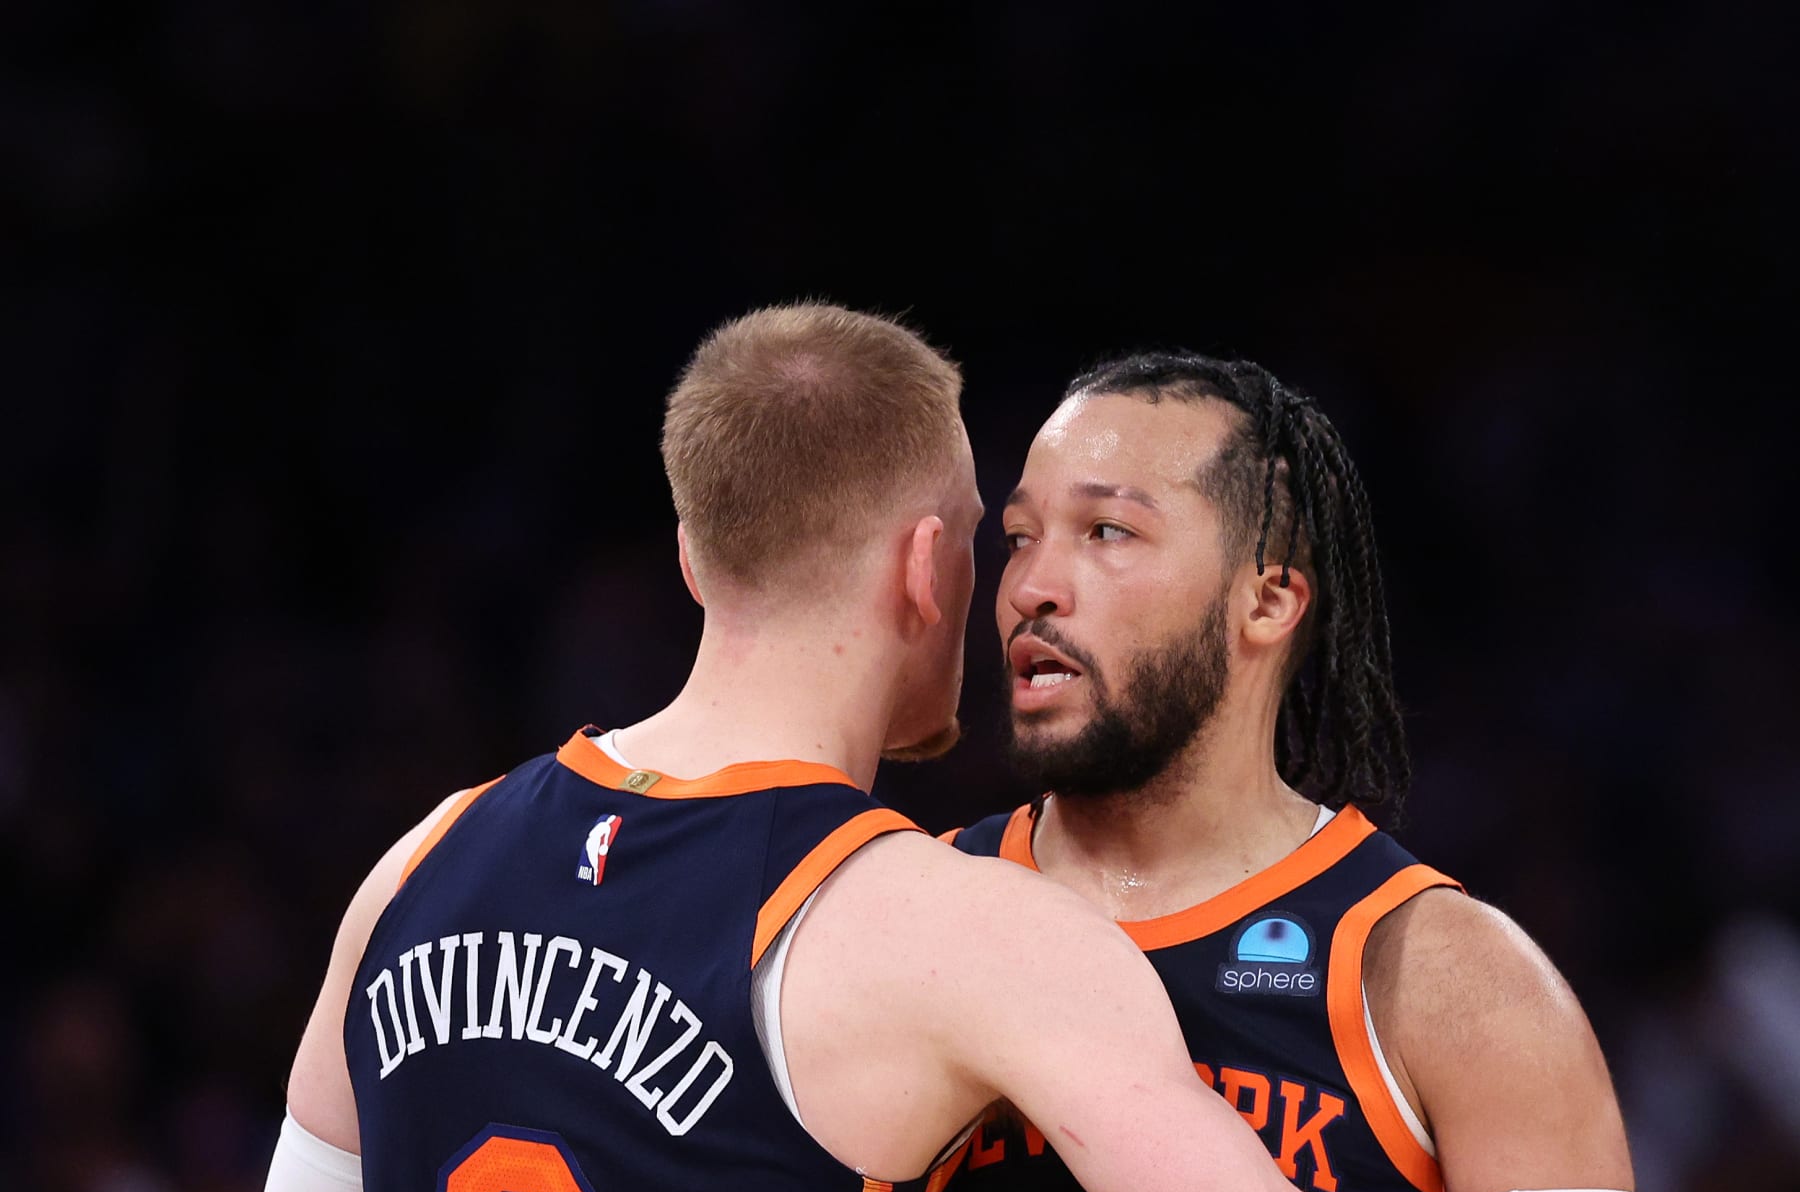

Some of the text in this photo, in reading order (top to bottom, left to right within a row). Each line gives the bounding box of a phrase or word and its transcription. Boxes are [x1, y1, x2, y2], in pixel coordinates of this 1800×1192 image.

[578, 865, 593, 881] NBA
[1223, 968, 1315, 992] sphere
[366, 931, 734, 1136] DIVINCENZO
